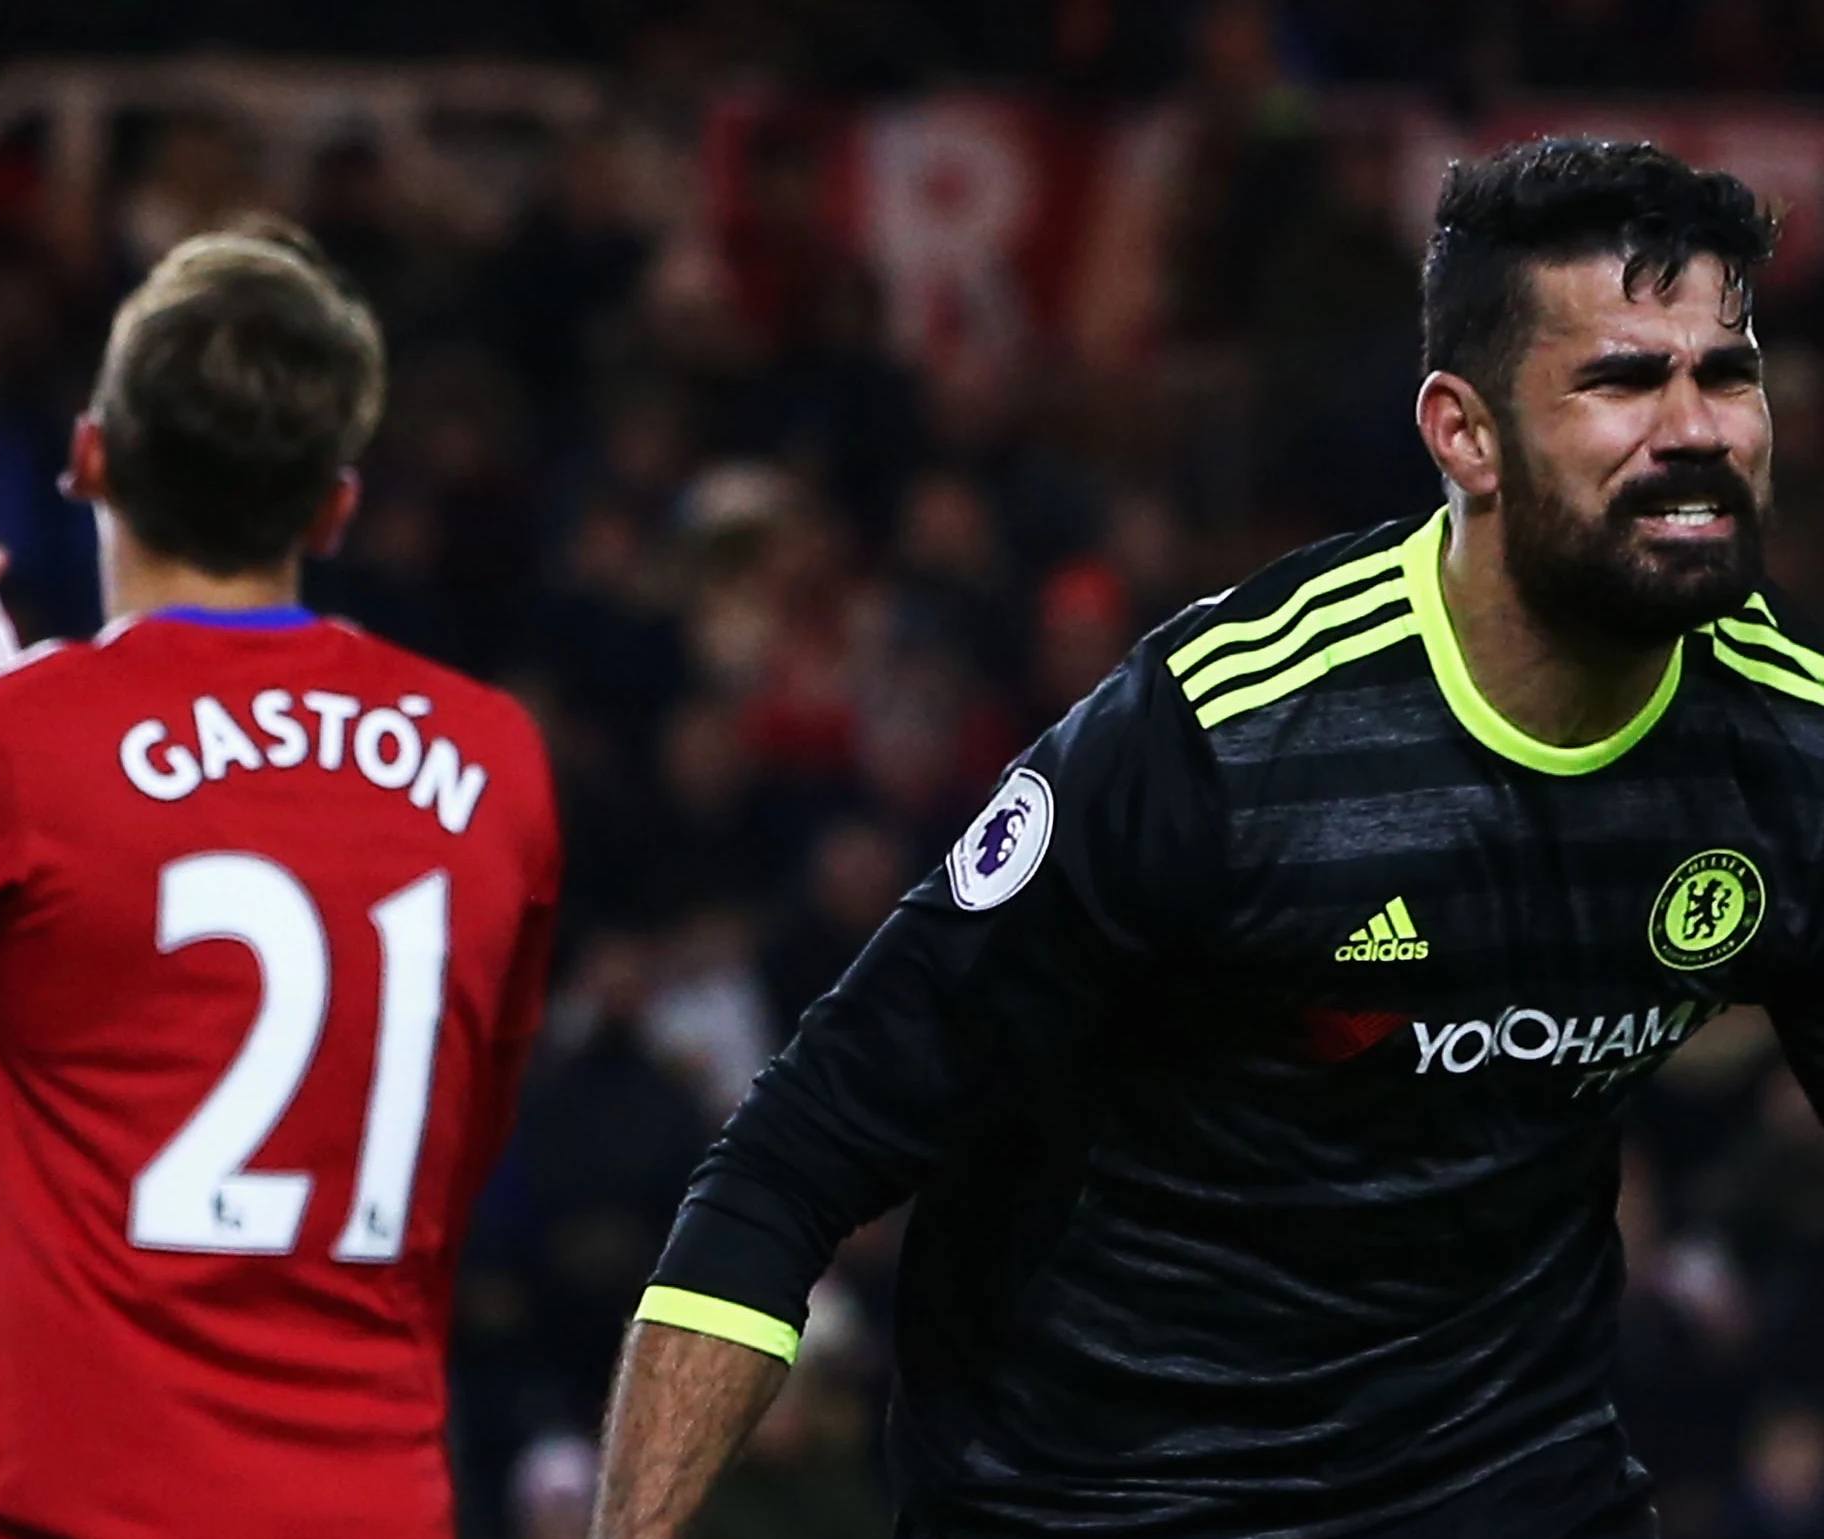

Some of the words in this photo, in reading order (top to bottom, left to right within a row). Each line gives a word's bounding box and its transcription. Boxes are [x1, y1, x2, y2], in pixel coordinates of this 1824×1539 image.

[119, 688, 489, 834] GASTÓN
[1334, 938, 1430, 962] adidas
[127, 848, 452, 1263] 21
